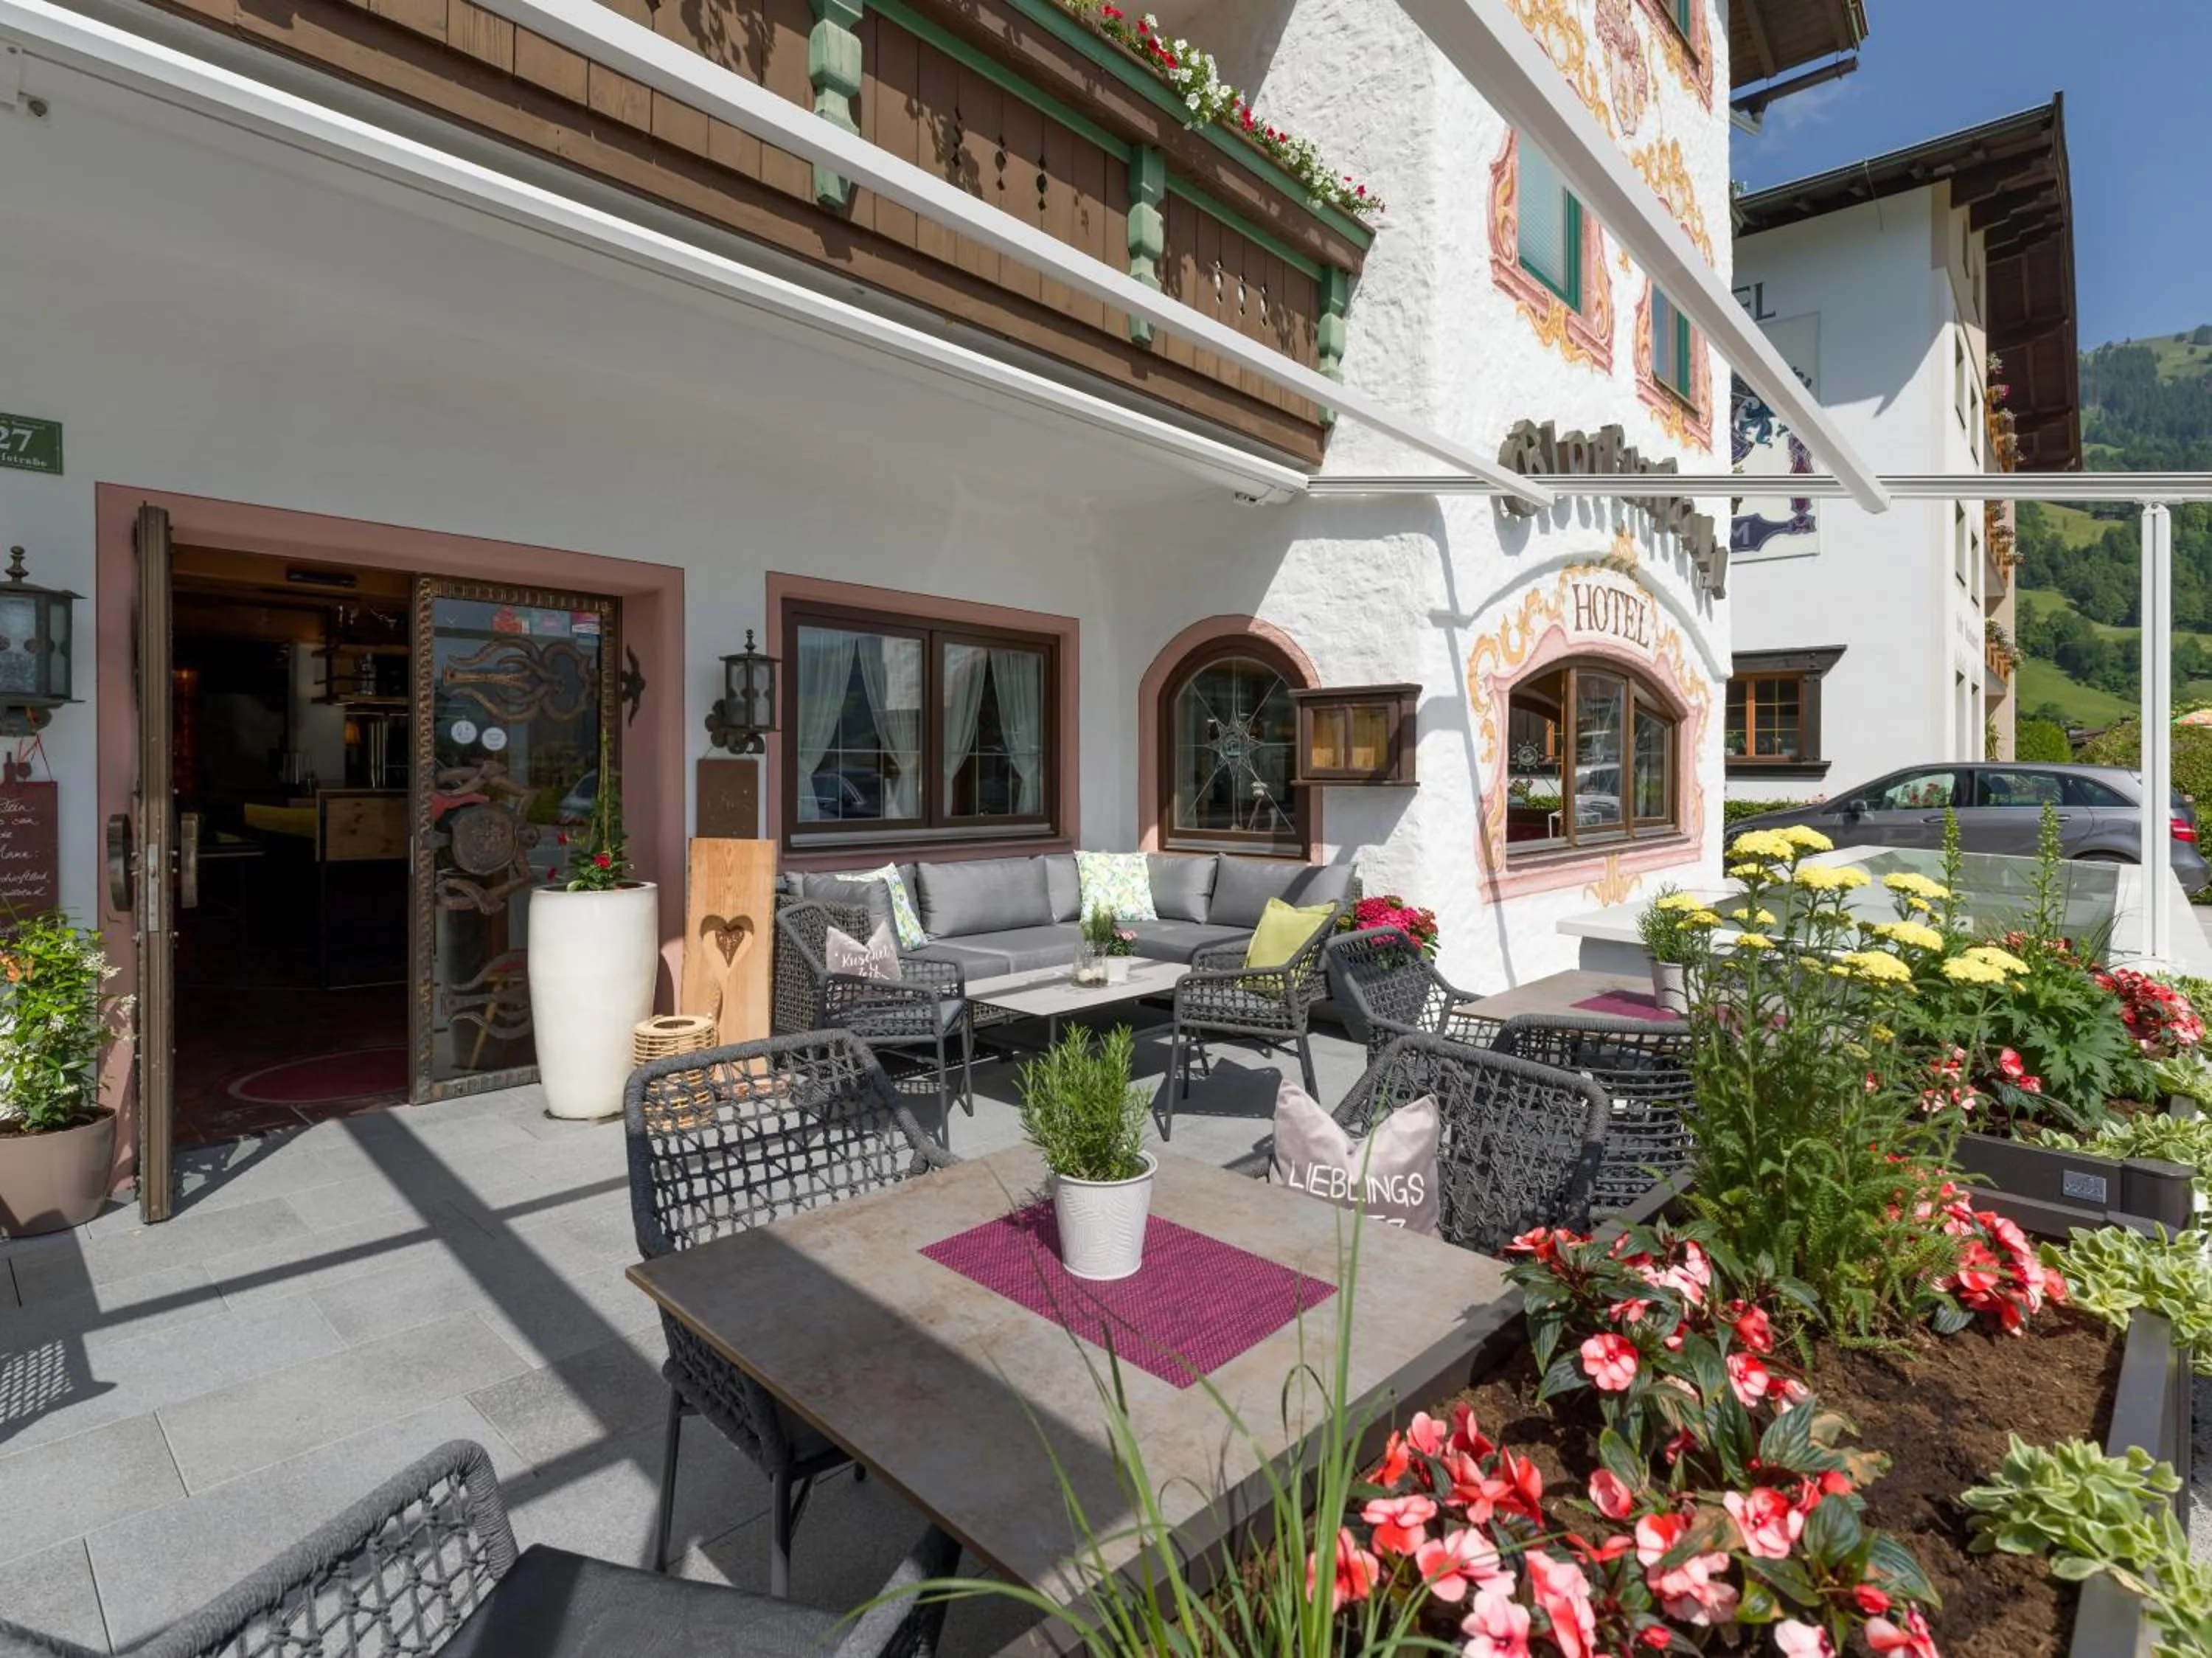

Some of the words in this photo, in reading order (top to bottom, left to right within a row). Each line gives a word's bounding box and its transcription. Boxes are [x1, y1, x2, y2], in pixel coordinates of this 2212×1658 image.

[0, 426, 33, 452] 27
[1571, 583, 1649, 649] HOTEL
[1288, 1161, 1425, 1208] LIEBLINGS
